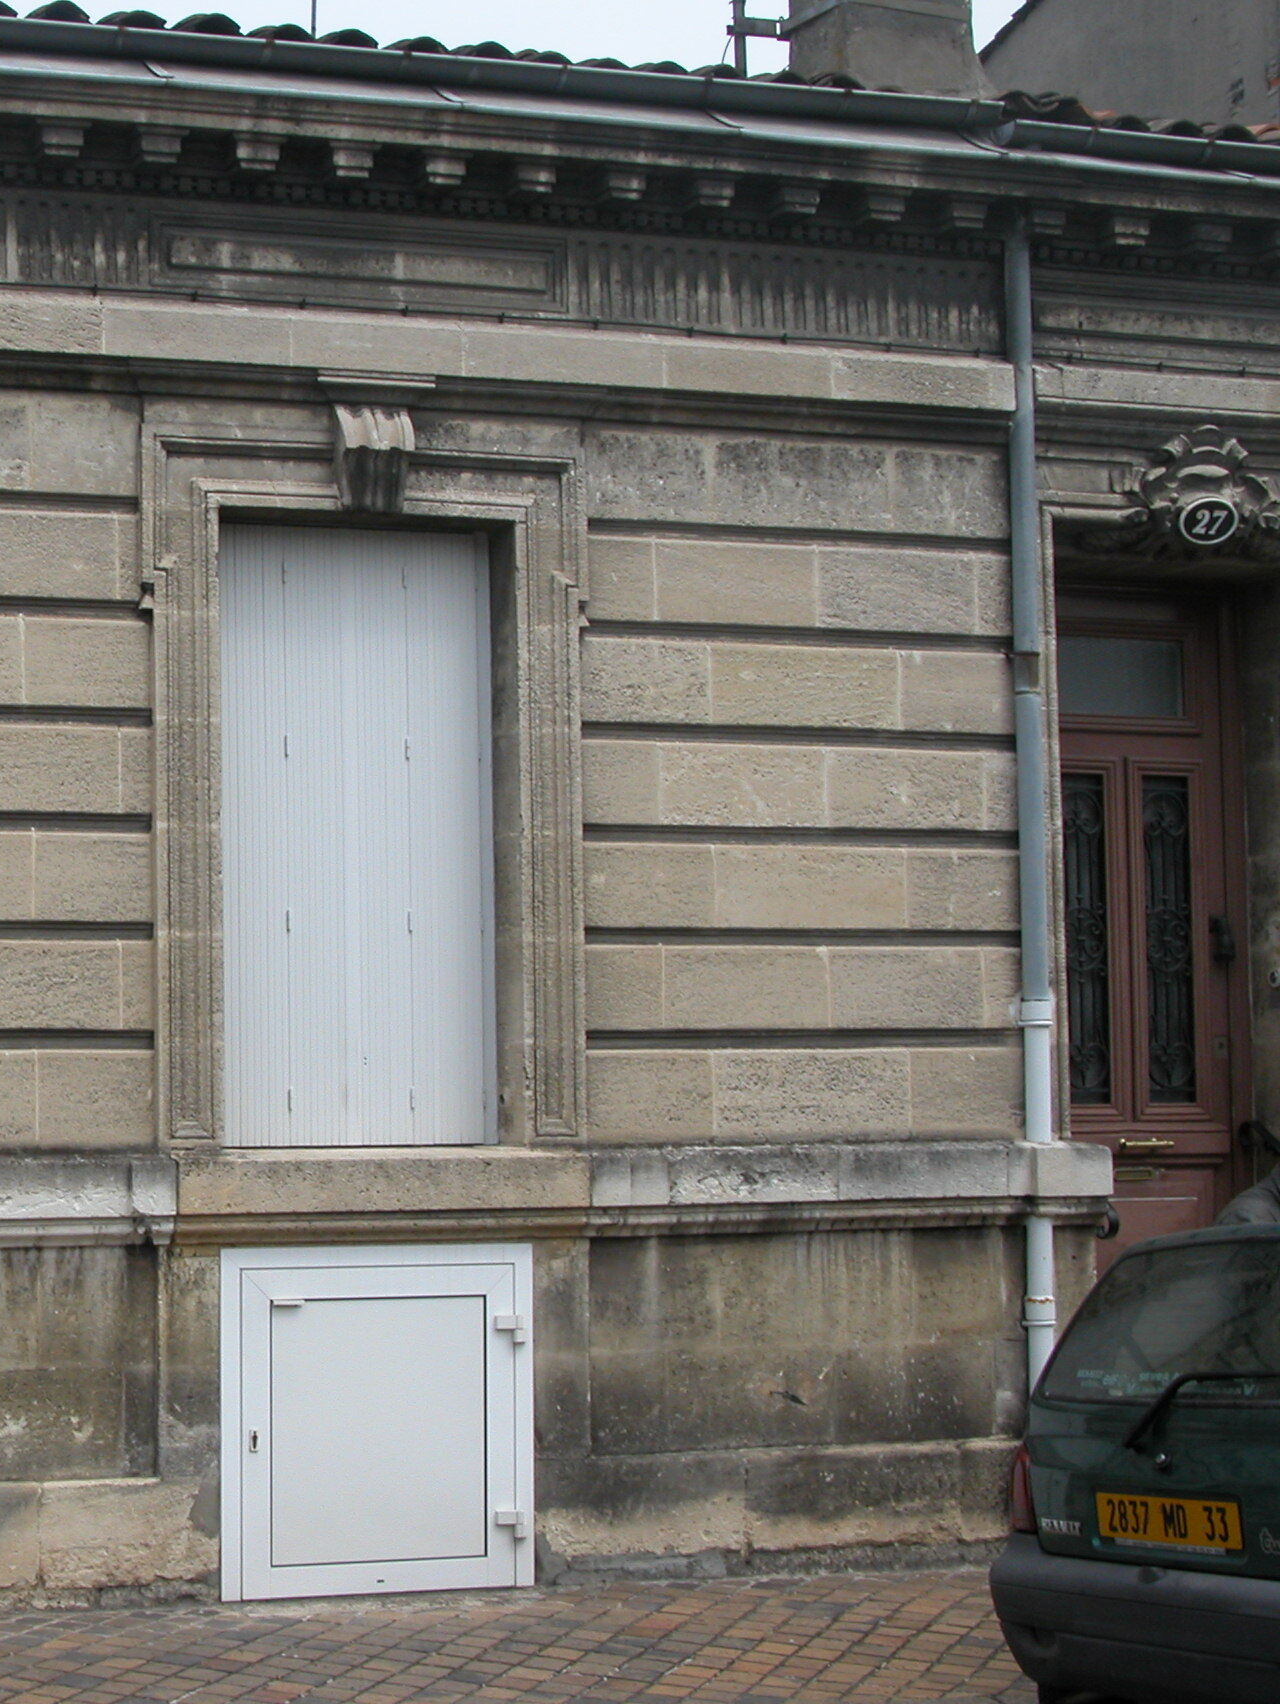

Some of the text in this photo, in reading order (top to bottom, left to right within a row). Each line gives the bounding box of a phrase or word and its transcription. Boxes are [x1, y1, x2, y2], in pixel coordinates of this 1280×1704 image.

[1191, 509, 1229, 535] 27
[1106, 1498, 1149, 1536] 2837
[1161, 1502, 1189, 1539] MD
[1202, 1505, 1230, 1542] 33
